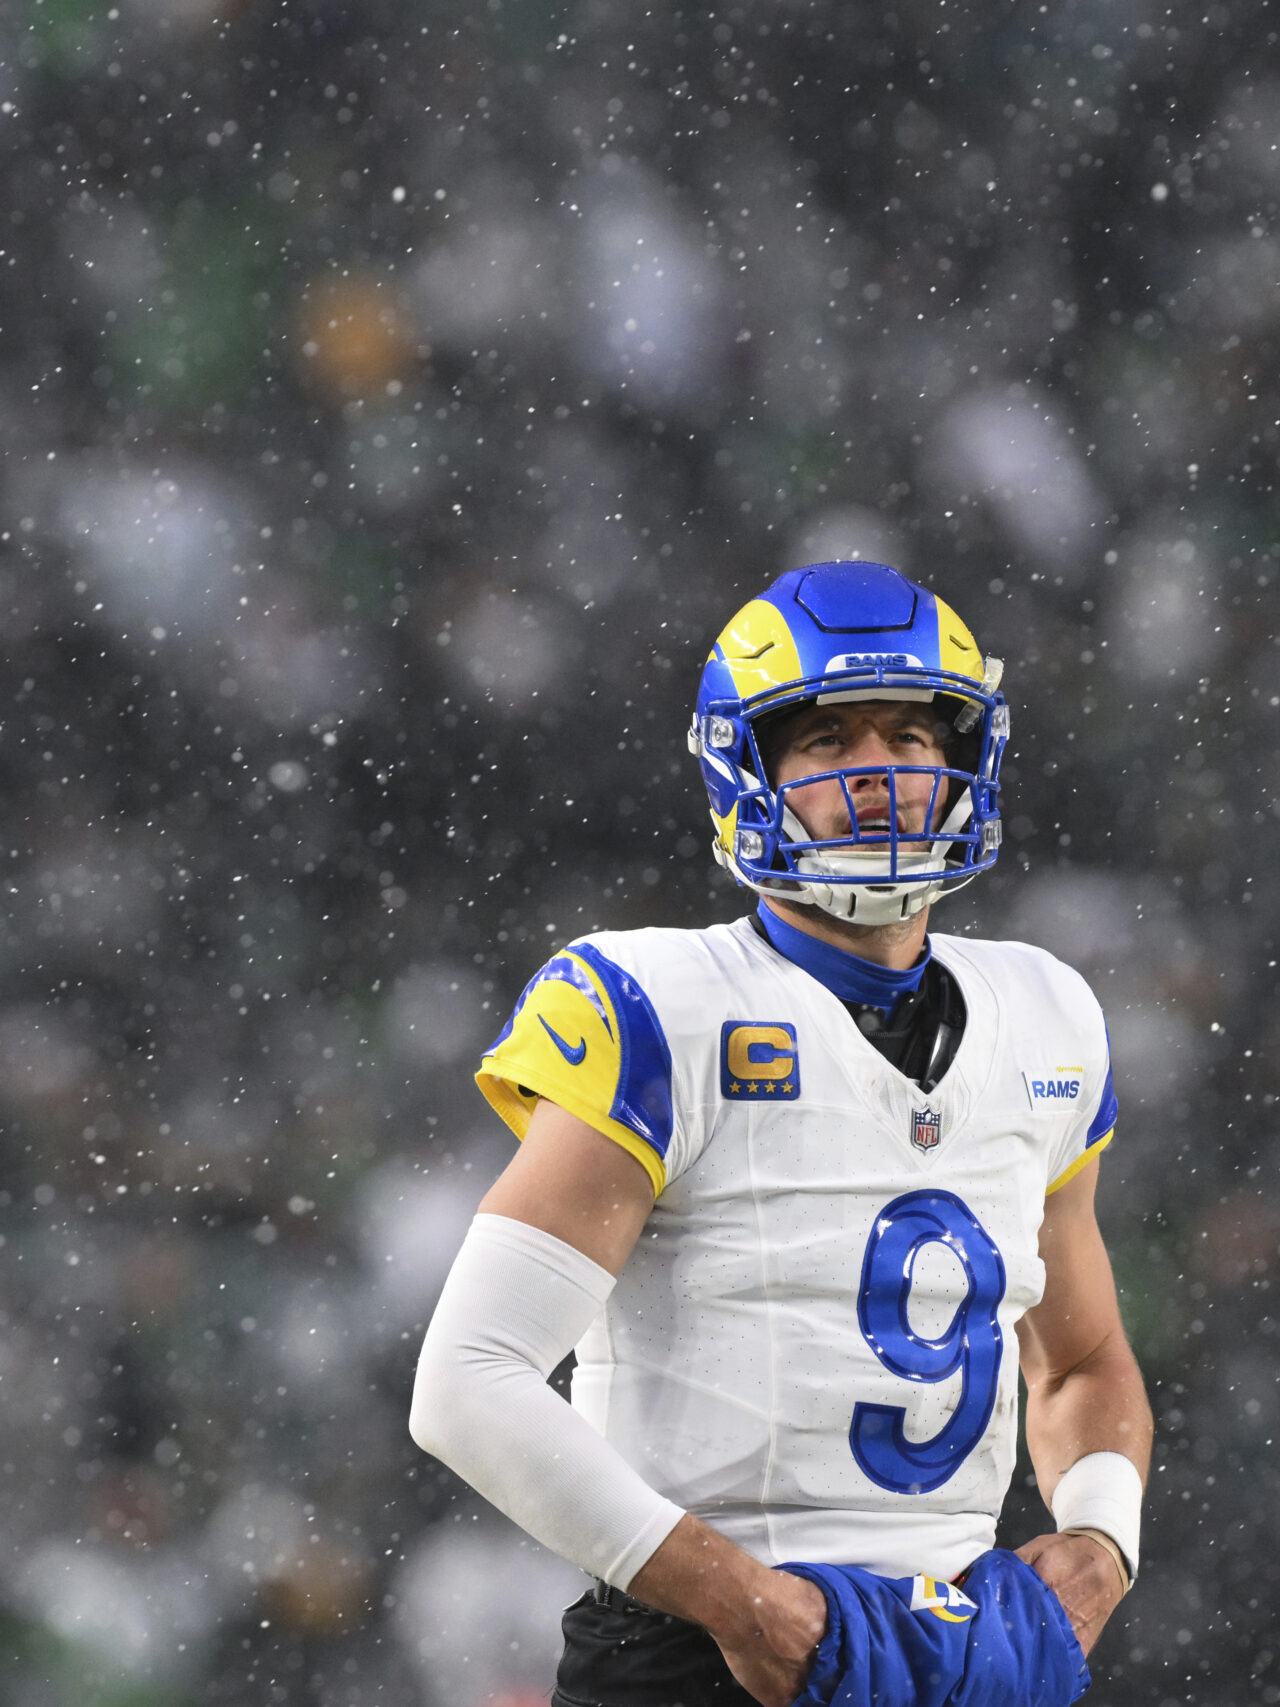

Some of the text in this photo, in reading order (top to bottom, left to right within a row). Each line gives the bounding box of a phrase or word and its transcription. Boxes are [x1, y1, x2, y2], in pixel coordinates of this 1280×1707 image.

[845, 654, 908, 668] RAMS
[727, 1026, 794, 1081] C
[1032, 1080, 1080, 1099] RAMS
[916, 1126, 937, 1145] NFL
[849, 1189, 1006, 1495] 9
